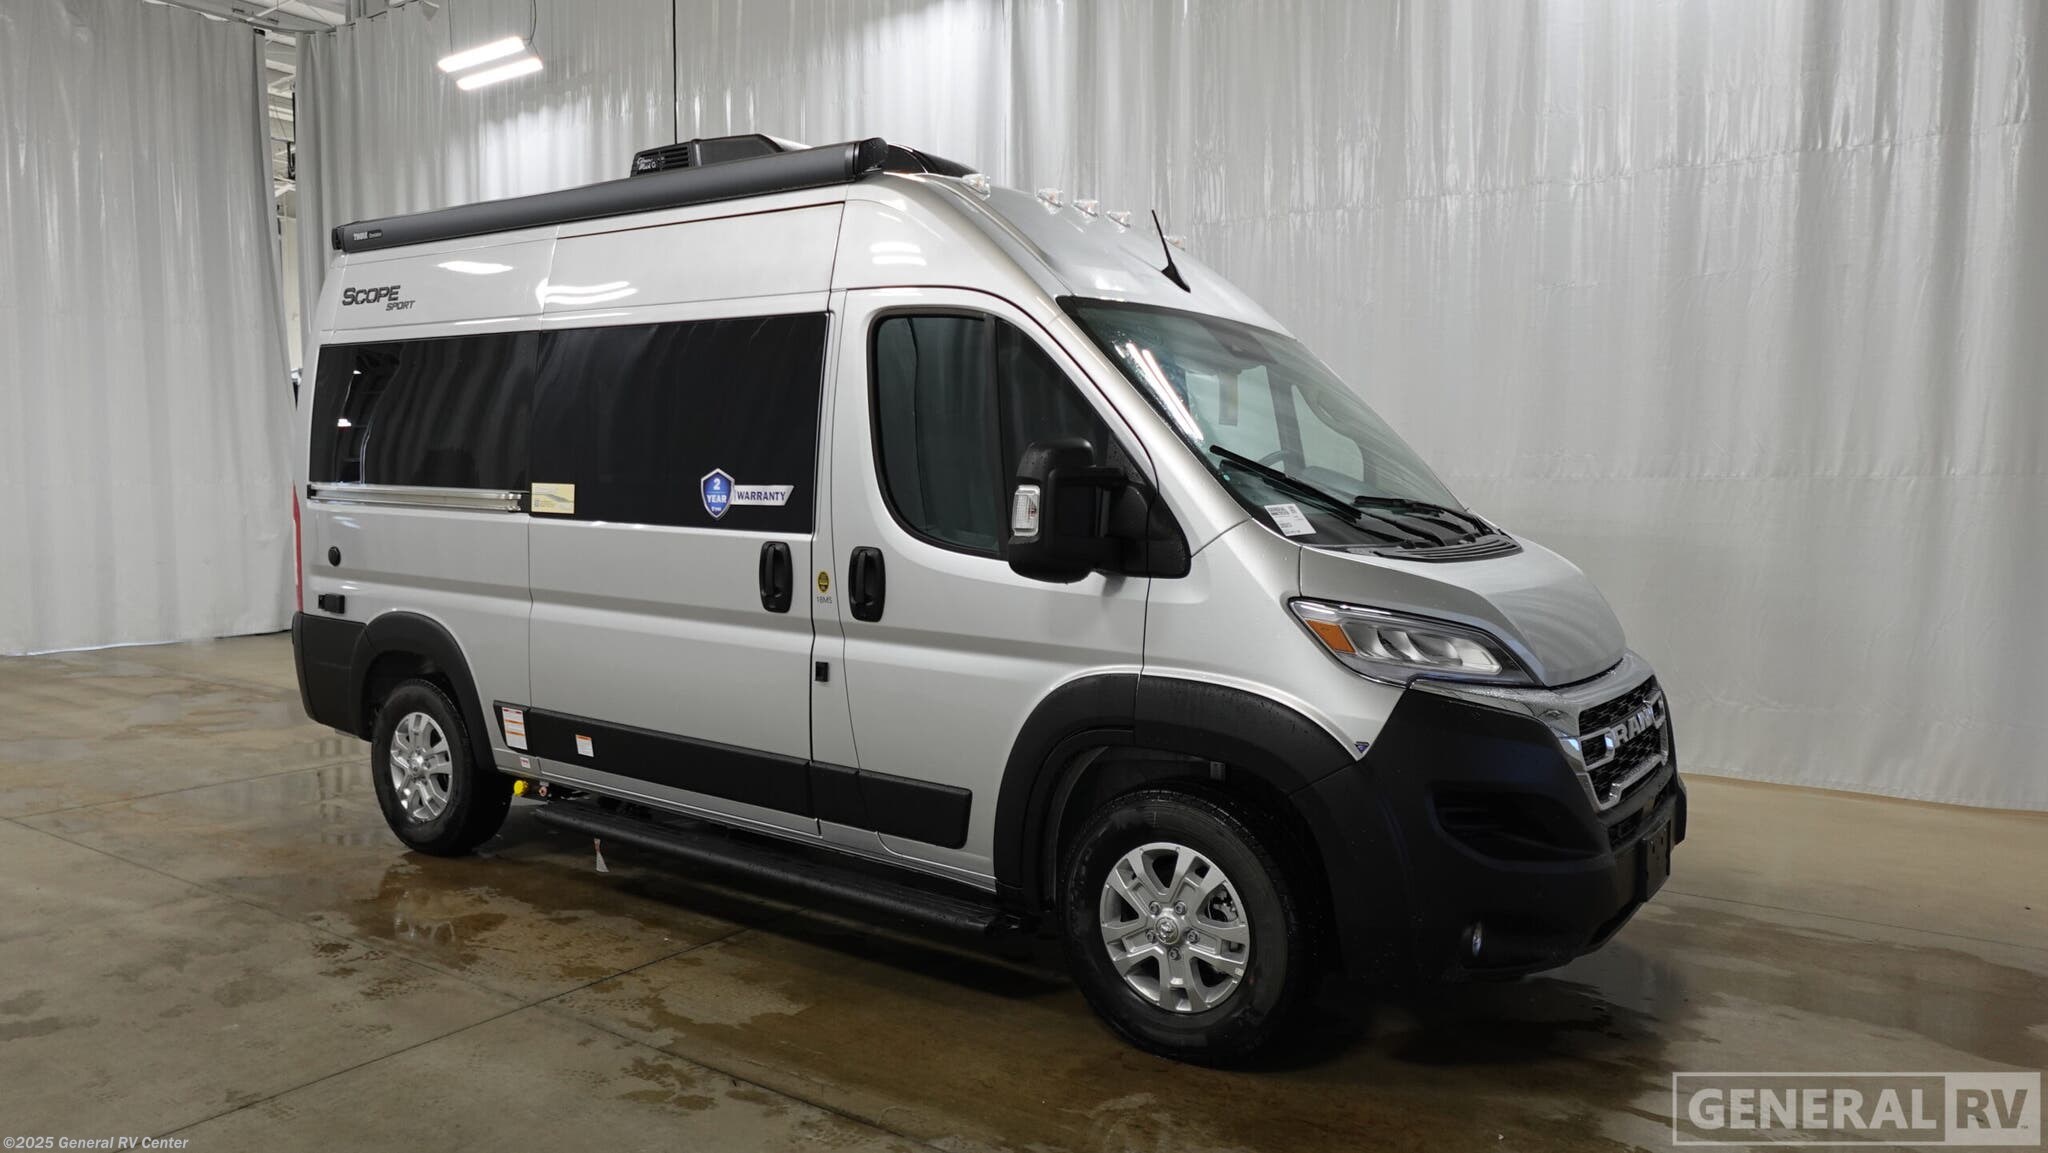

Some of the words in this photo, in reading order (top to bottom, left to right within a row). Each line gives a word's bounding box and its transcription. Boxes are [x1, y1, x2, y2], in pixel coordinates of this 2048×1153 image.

[342, 285, 401, 306] SCOPE
[385, 300, 416, 312] SPORT
[713, 478, 721, 491] 2
[706, 494, 727, 503] YEAR
[737, 491, 786, 501] WARRANTY
[1611, 705, 1655, 748] RAM
